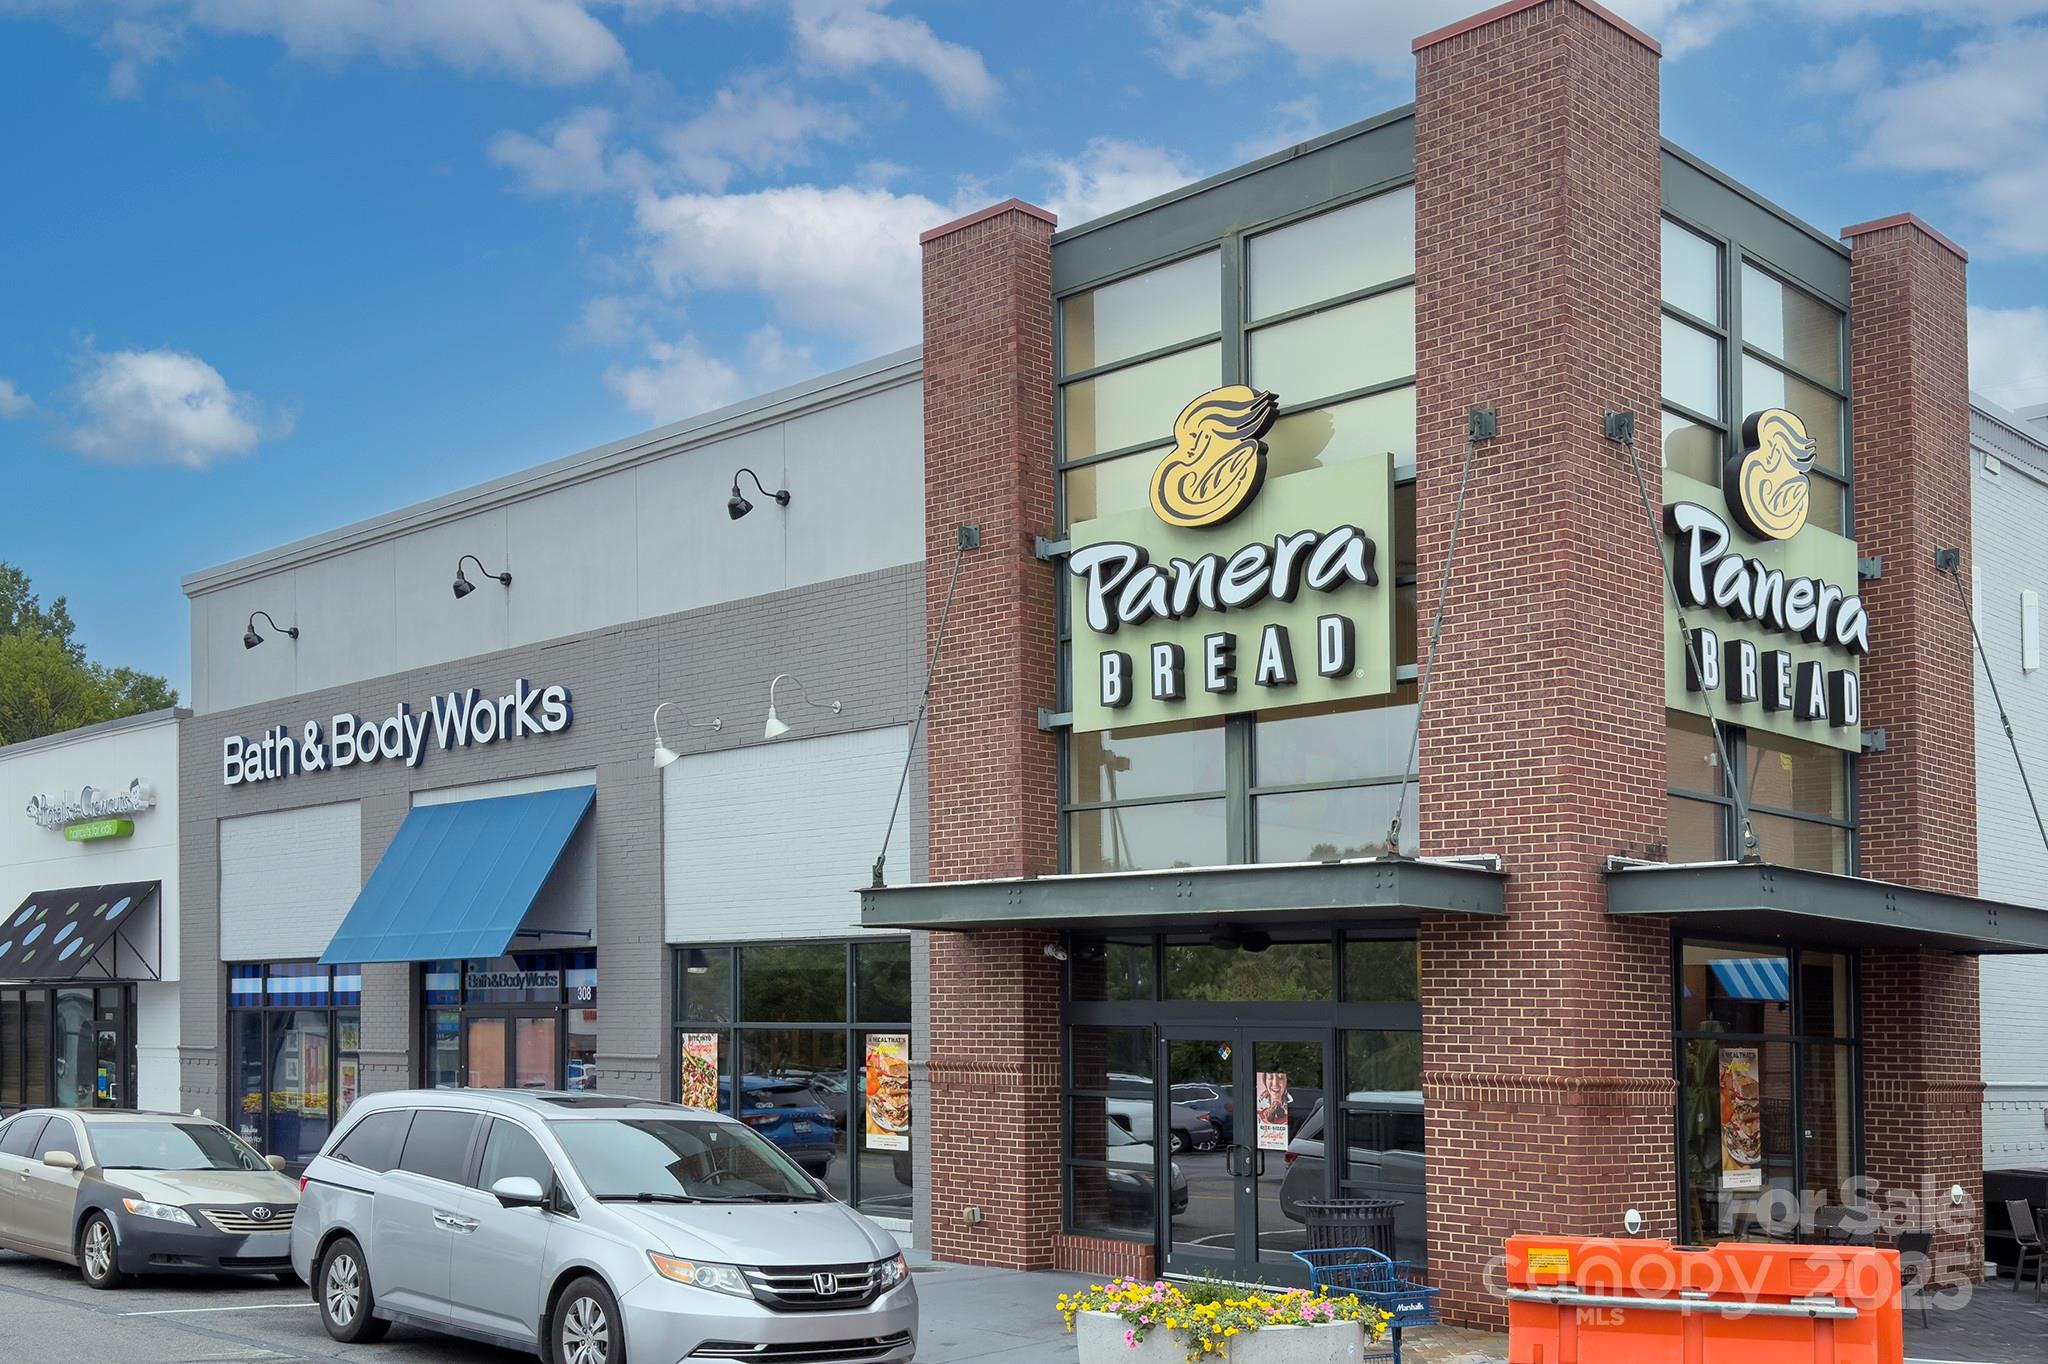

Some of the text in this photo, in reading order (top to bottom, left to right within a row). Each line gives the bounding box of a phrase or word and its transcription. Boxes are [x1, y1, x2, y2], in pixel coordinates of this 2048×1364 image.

[1069, 524, 1378, 634] Panera
[1667, 501, 1870, 655] Panera
[1099, 613, 1355, 708] BREAD
[1686, 628, 1859, 728] BREAD
[223, 678, 574, 786] Bath & Body Works
[468, 973, 491, 988] Bath
[500, 972, 525, 989] Body
[525, 972, 558, 986] Works
[577, 986, 592, 1001] 308
